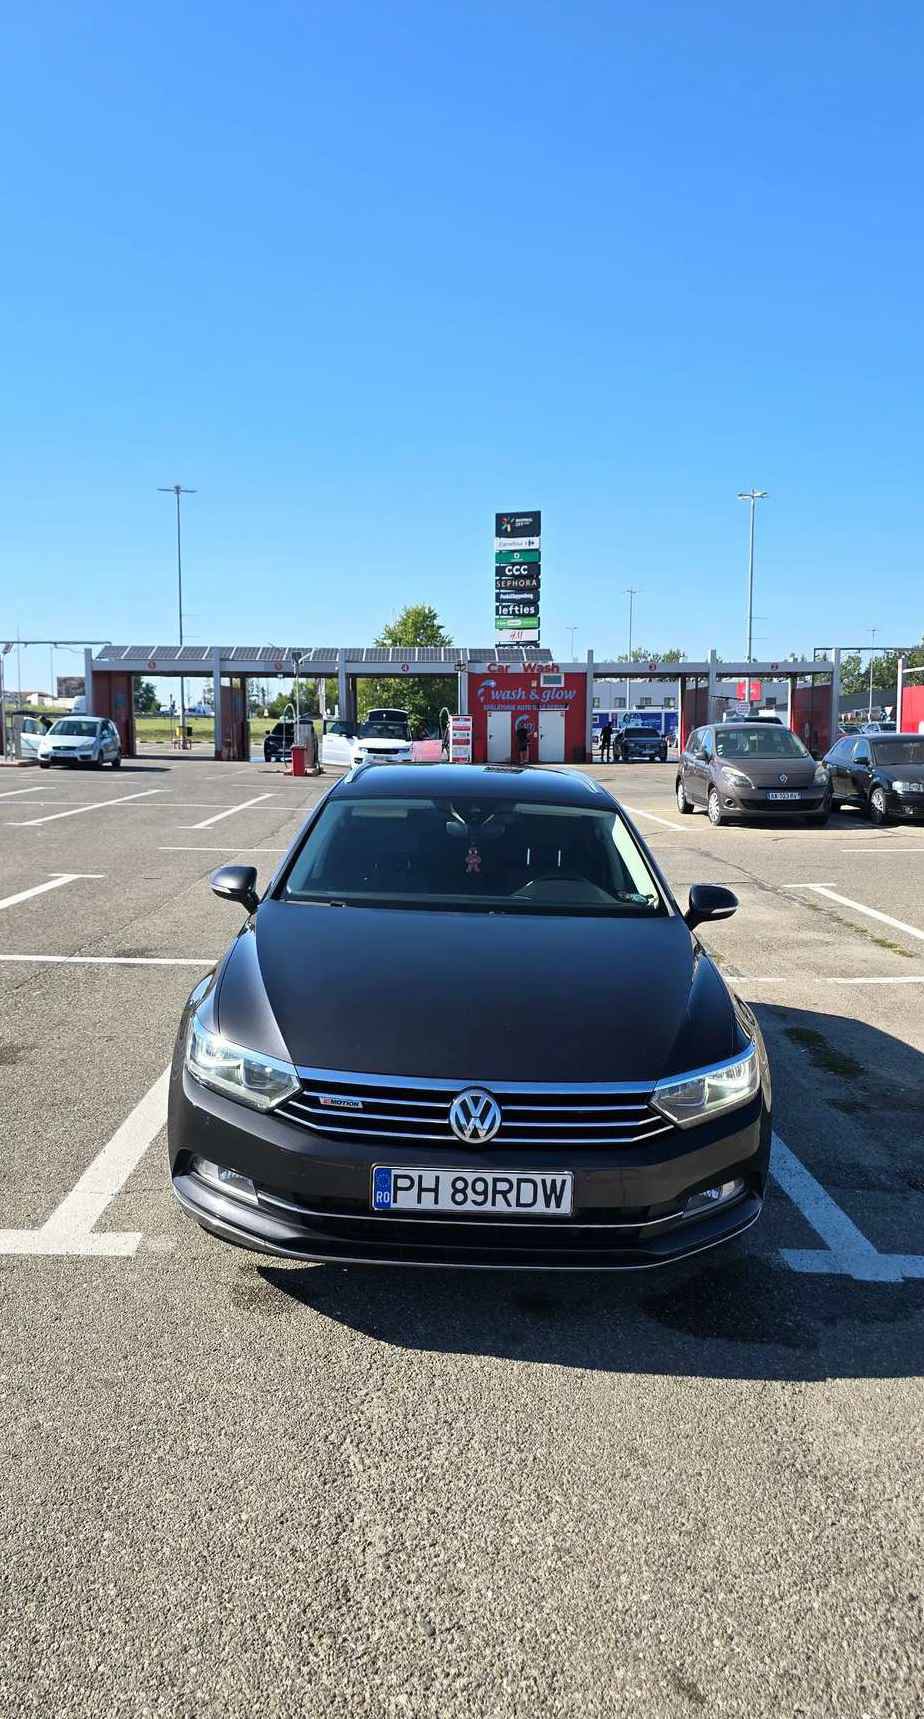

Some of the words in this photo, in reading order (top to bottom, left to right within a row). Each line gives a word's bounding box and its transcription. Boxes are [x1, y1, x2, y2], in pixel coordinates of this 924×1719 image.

[505, 565, 529, 575] CCC
[496, 578, 538, 588] SEPHORA
[498, 604, 536, 615] lefties
[487, 663, 511, 673] Car
[522, 663, 560, 673] Wash
[491, 688, 527, 700] wash
[529, 688, 540, 700] &
[541, 688, 576, 702] glow
[376, 1191, 391, 1203] RO
[392, 1174, 440, 1205] PH
[451, 1176, 567, 1209] 89RDW
